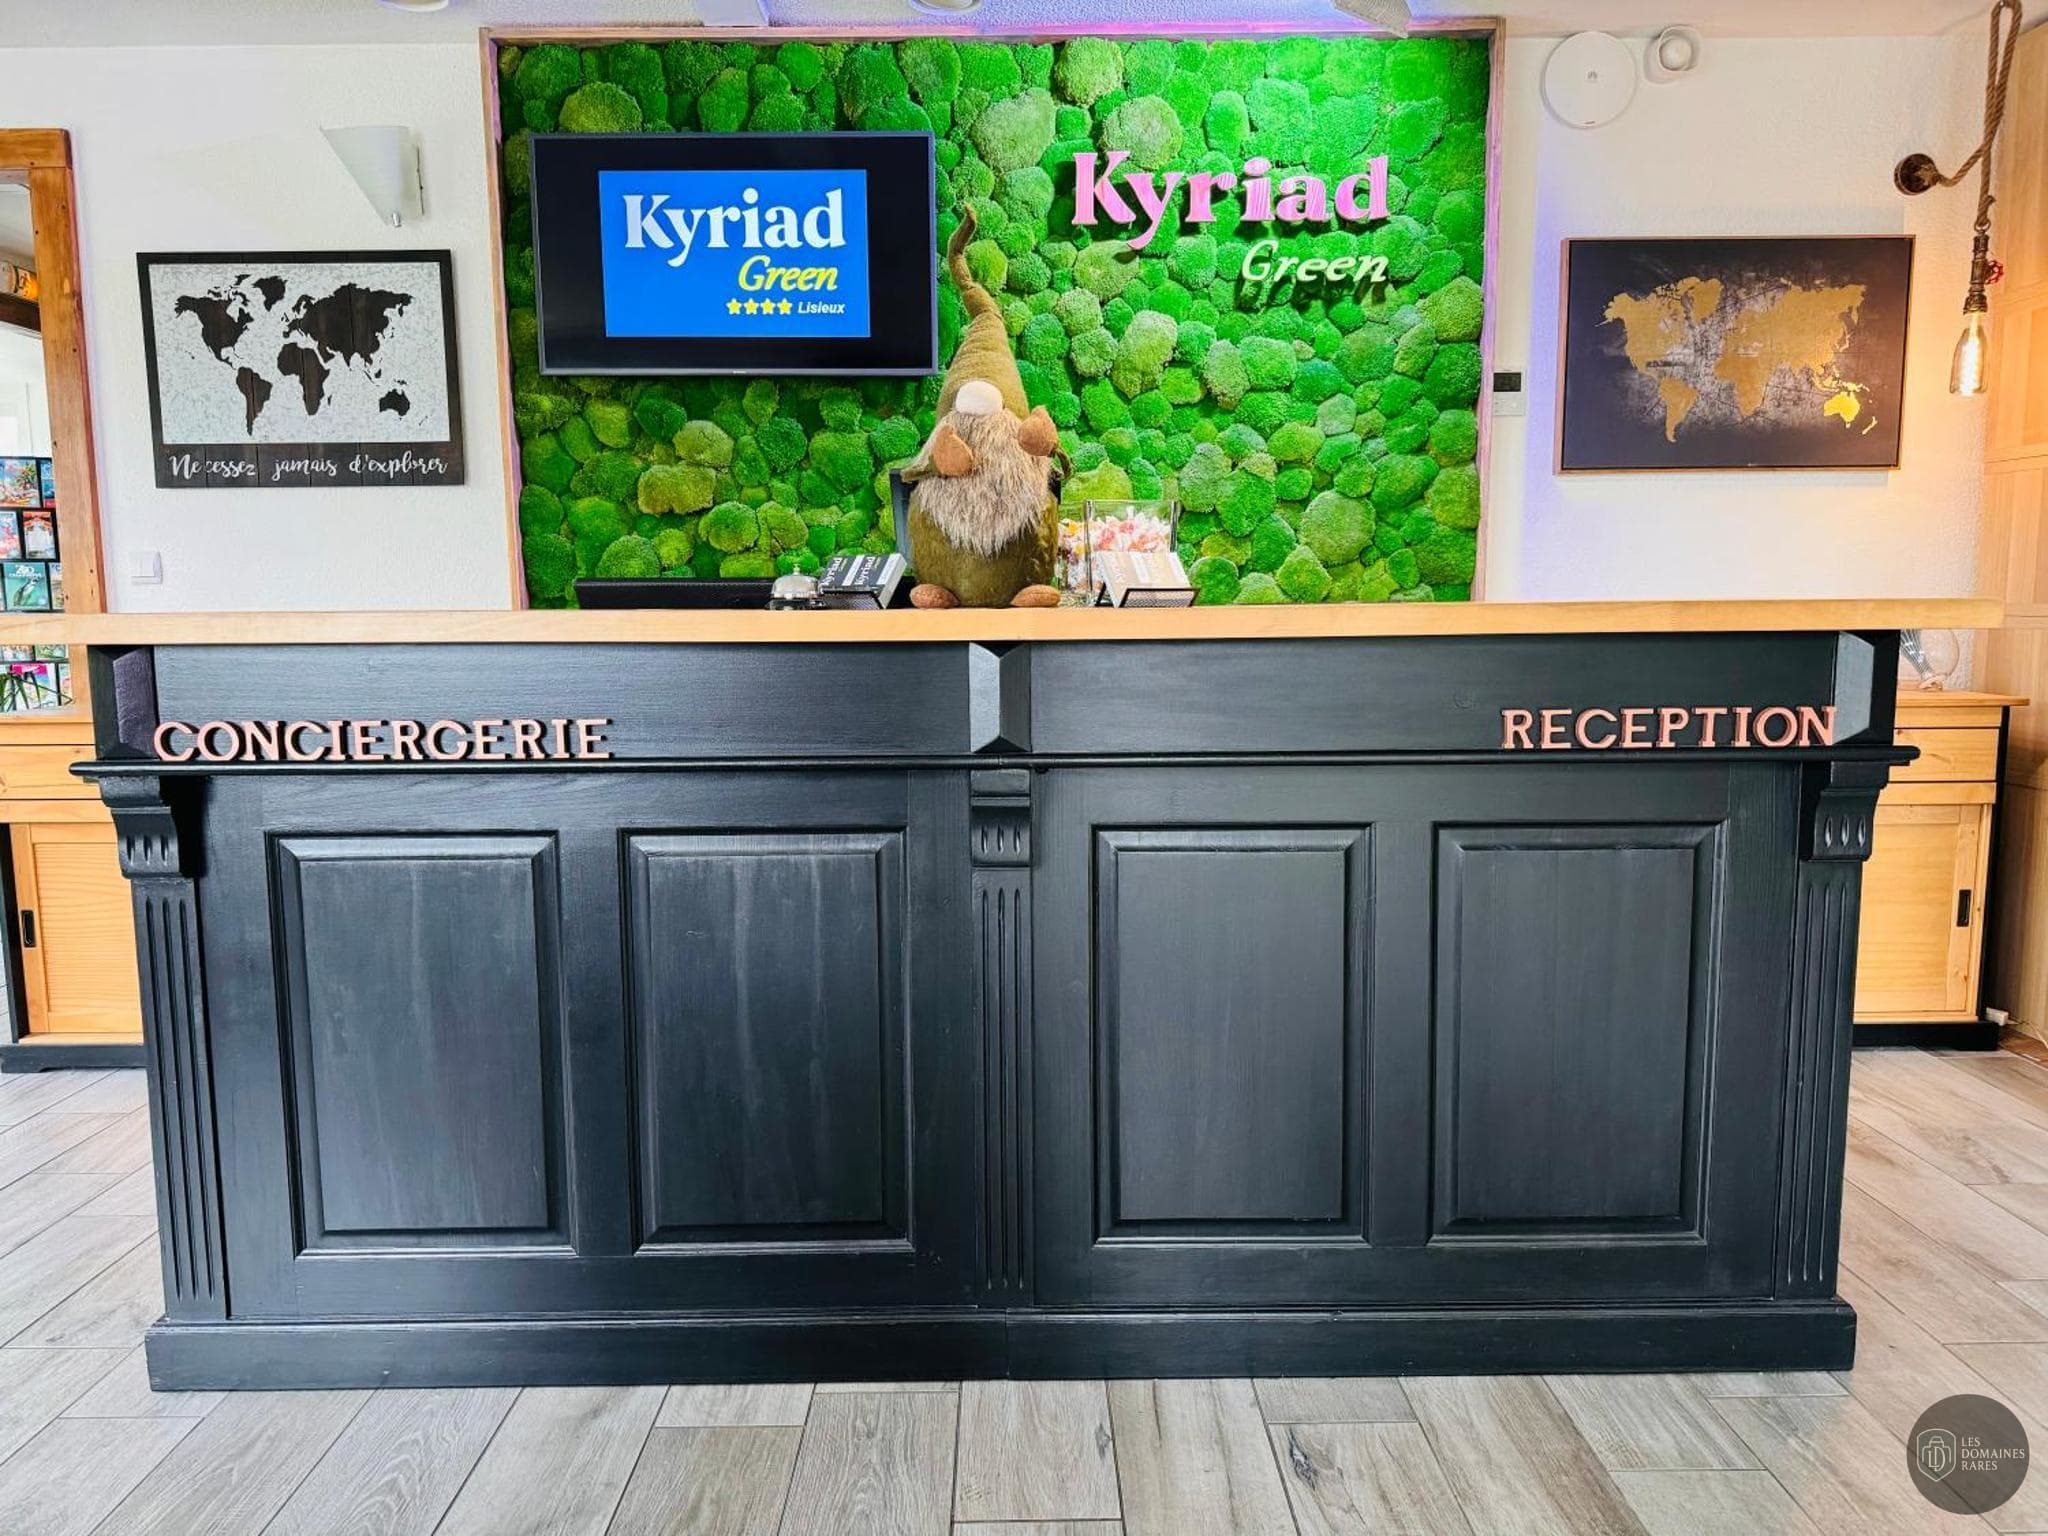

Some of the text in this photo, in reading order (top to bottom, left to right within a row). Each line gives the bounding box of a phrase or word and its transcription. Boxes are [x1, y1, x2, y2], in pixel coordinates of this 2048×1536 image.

[1072, 151, 1389, 250] Kyriad
[622, 187, 847, 267] Kyriad
[738, 255, 838, 292] Green
[1242, 240, 1389, 283] Green
[798, 301, 845, 314] Lisieux
[169, 450, 448, 481] Ne cessez jamais d'explorer
[153, 719, 612, 761] CONCIERGERIE
[1502, 706, 1836, 749] RECEPTION
